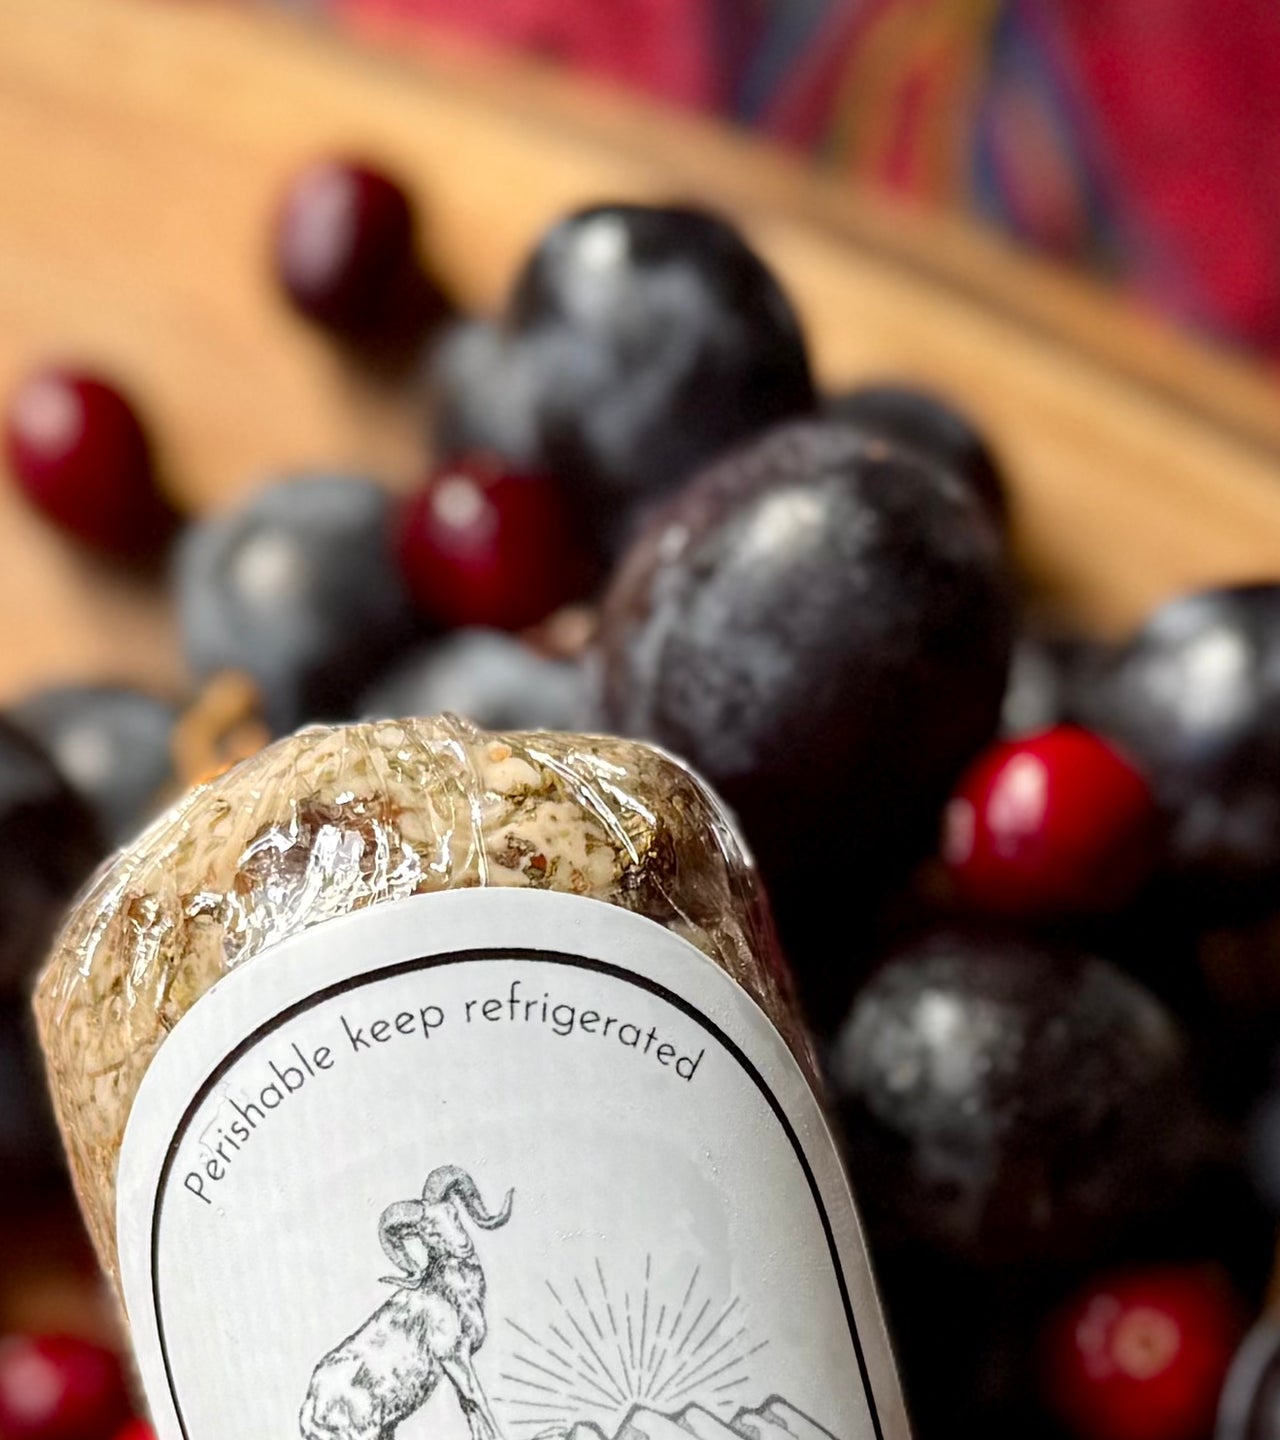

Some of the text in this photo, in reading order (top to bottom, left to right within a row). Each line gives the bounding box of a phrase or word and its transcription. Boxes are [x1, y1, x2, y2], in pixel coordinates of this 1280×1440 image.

[183, 980, 707, 1205] Perishable keep refrigerated
